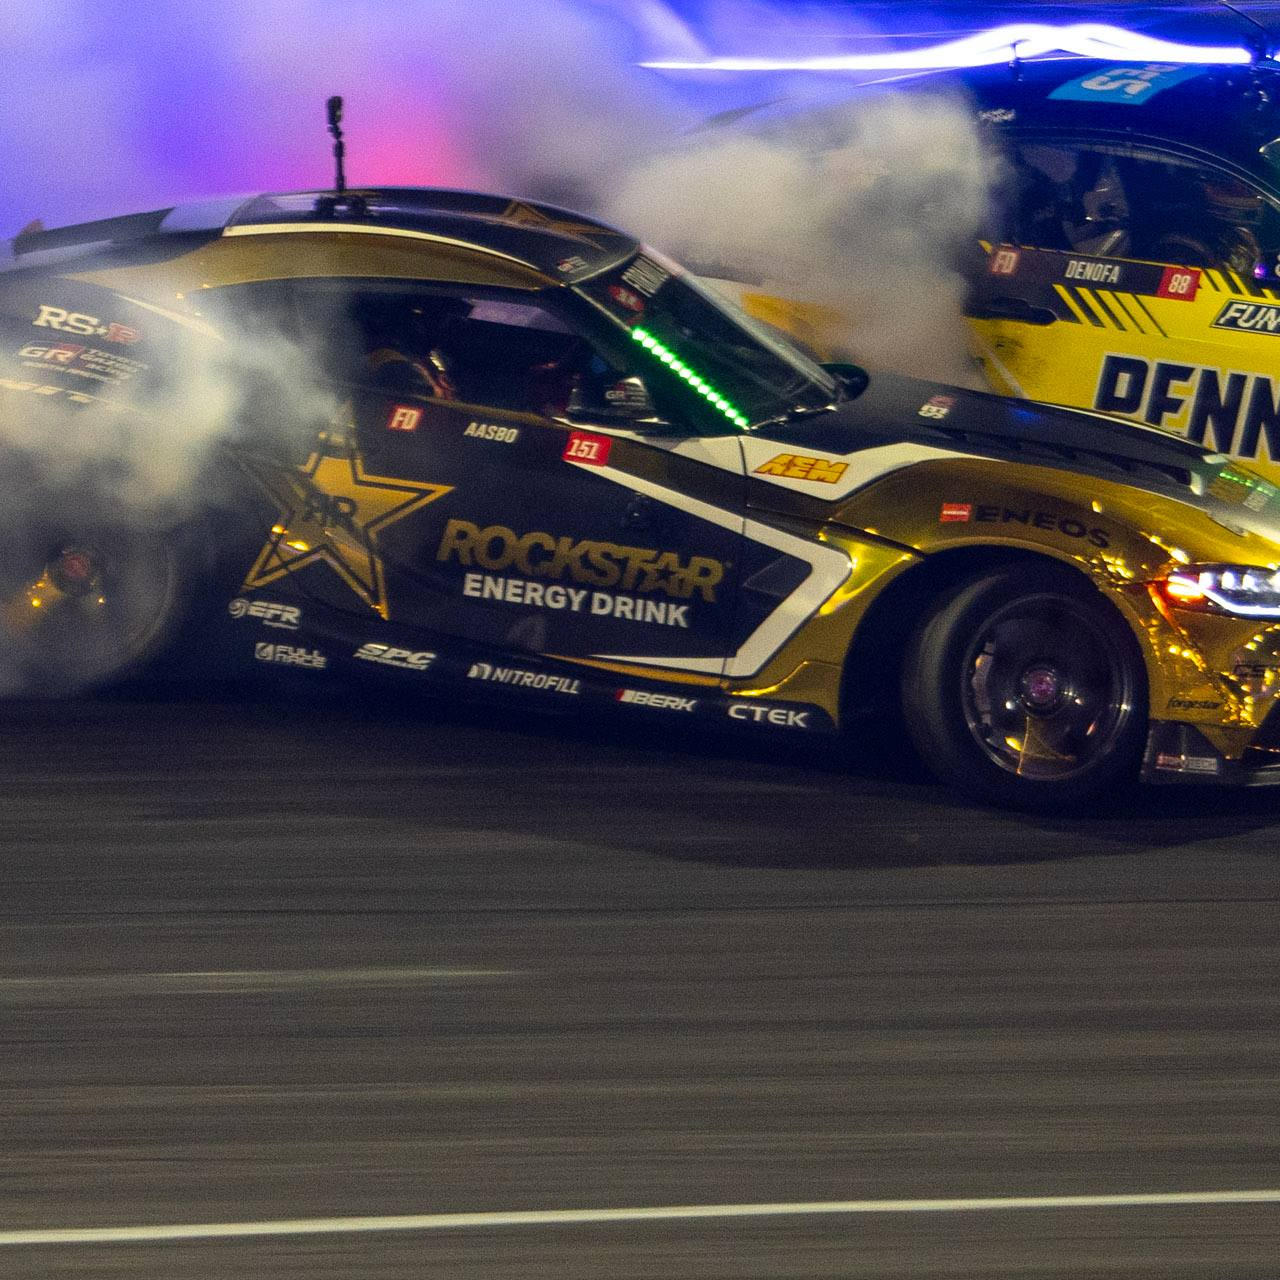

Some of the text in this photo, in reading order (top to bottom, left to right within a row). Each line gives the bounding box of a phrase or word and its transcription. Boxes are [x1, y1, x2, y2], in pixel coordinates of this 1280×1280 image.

[992, 251, 1018, 274] FD
[1065, 260, 1121, 284] DENOFA
[1168, 274, 1192, 294] 88
[390, 408, 418, 430] FD
[464, 422, 519, 444] AASBO
[567, 438, 601, 460] 151
[976, 504, 1110, 549] ENEOS
[436, 519, 724, 604] ROCKSTAR
[247, 600, 302, 624] EFR
[463, 573, 689, 629] ENERGY DRINK
[492, 667, 580, 695] NITROFILL
[632, 690, 699, 712] BERK
[728, 704, 810, 728] CTEK
